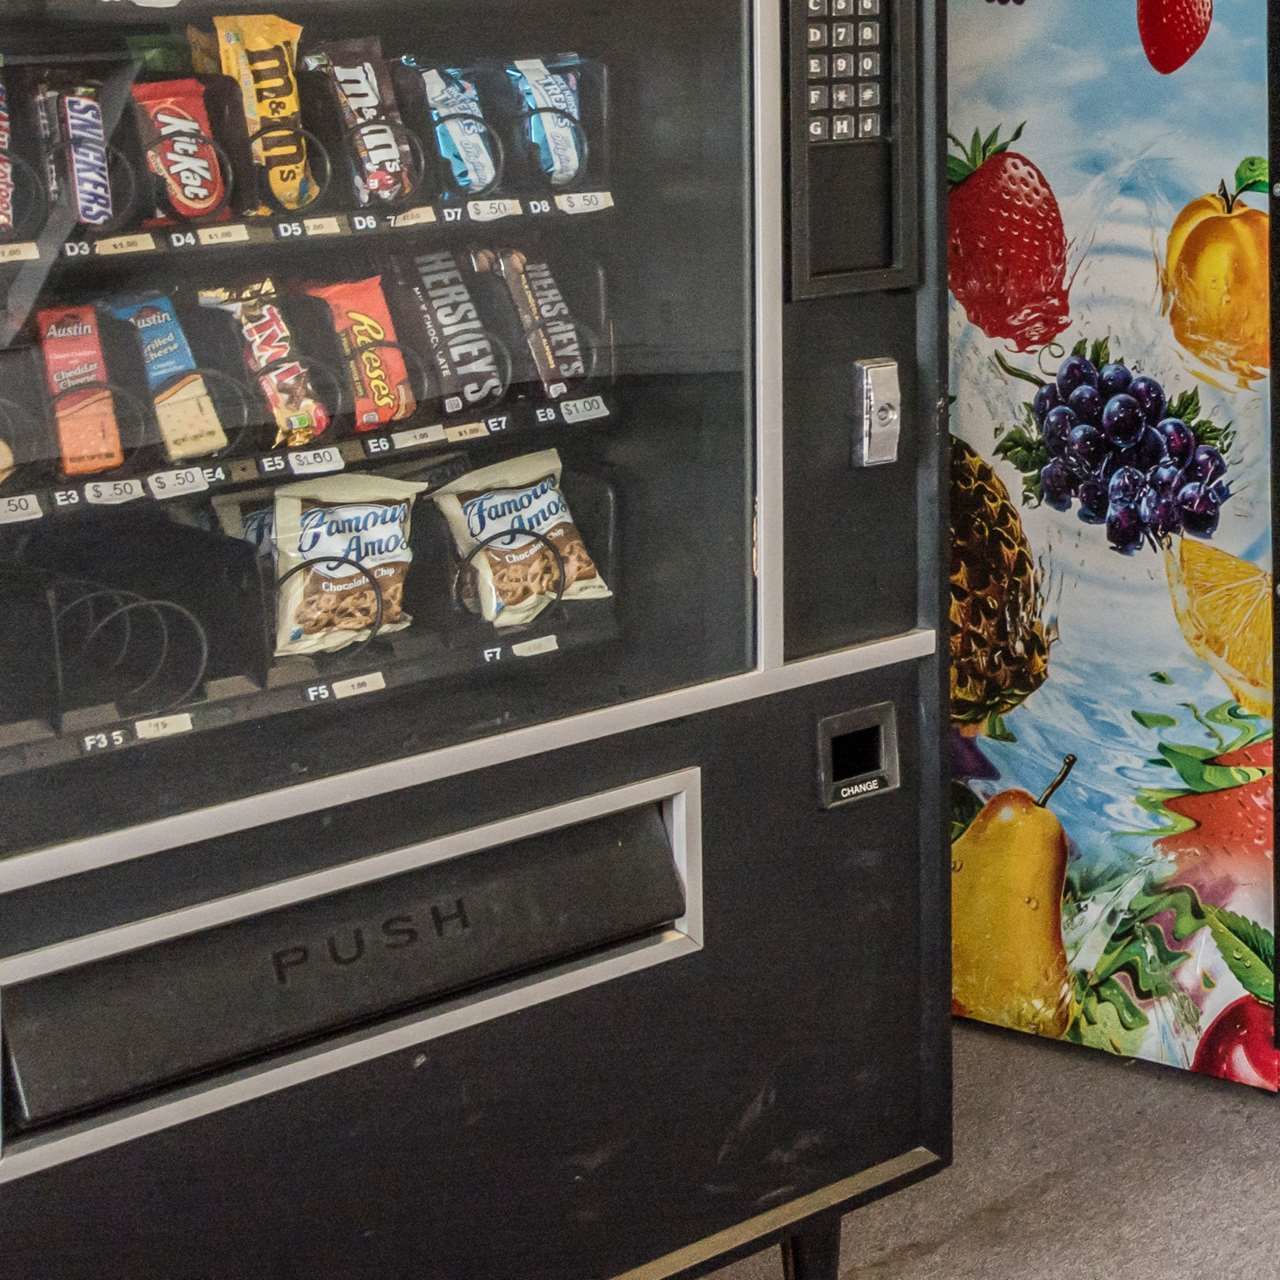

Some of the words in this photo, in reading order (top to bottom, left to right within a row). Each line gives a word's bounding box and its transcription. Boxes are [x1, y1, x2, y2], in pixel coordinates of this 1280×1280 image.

[809, 29, 821, 41] D
[837, 28, 846, 40] 7
[863, 27, 872, 39] 8
[809, 60, 820, 72] E
[837, 59, 846, 71] 9
[863, 58, 872, 69] 0
[810, 91, 820, 103] F
[809, 122, 821, 134] G
[836, 121, 848, 133] H
[864, 119, 872, 131] J
[67, 97, 113, 223] SNICKERS
[443, 208, 462, 221] D7
[530, 201, 550, 213] D8
[279, 222, 302, 236] D5
[354, 215, 376, 229] D6
[171, 232, 196, 246] D4
[65, 242, 90, 256] D3
[47, 323, 92, 338] Austin
[536, 408, 556, 423] E8
[563, 399, 600, 416] $1.00
[487, 417, 508, 432] E7
[368, 438, 389, 453] E6
[262, 457, 285, 471] E5
[204, 468, 225, 482] E4
[55, 490, 79, 505] E3
[321, 576, 370, 593] Chocolat
[374, 567, 395, 580] Chip
[483, 647, 502, 662] F7
[308, 685, 330, 701] F5
[84, 734, 108, 751] F3
[112, 730, 123, 745] 5
[841, 779, 879, 797] CHANGE
[270, 897, 472, 985] PUSH
